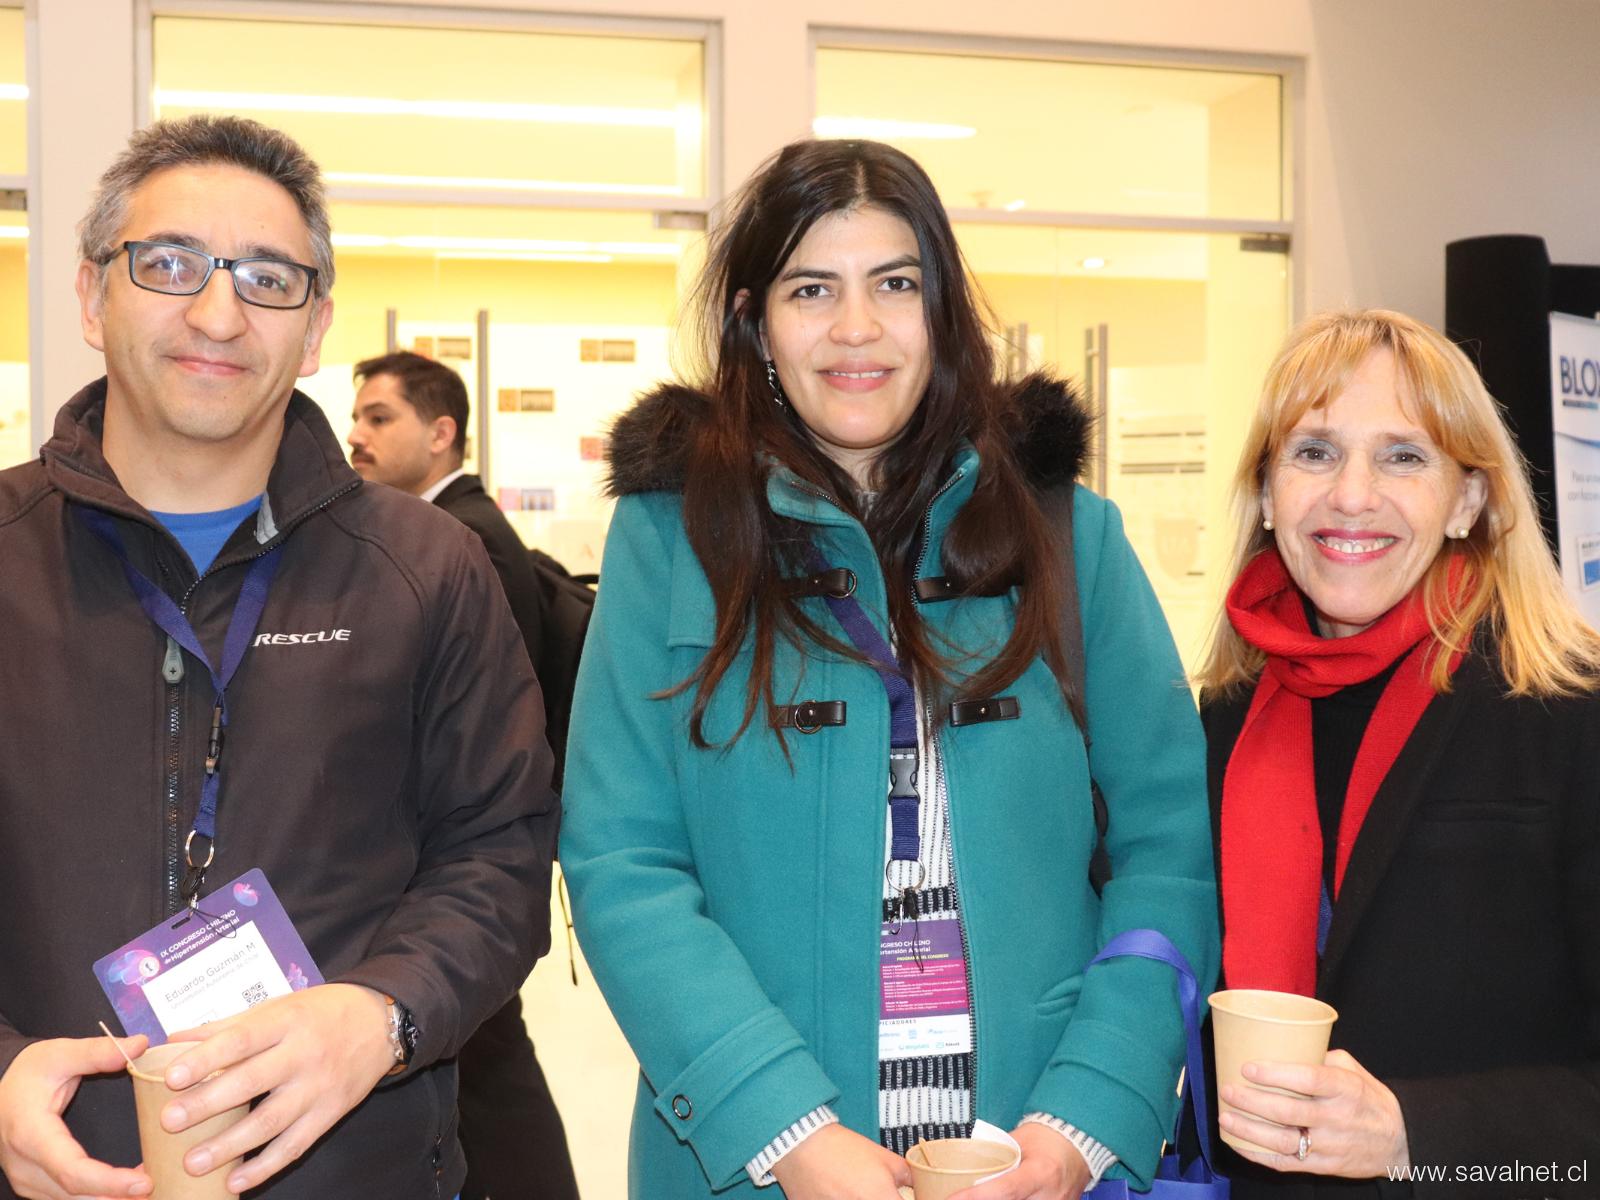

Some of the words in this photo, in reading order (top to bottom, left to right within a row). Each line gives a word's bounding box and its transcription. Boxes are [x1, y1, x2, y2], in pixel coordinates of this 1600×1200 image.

[252, 629, 352, 647] RESCUE
[160, 949, 169, 958] IX
[169, 928, 206, 953] CONGRESO
[171, 933, 215, 961] Hipertensión
[165, 975, 205, 1002] Eduardo
[206, 950, 245, 976] Guzmán
[246, 942, 256, 952] M
